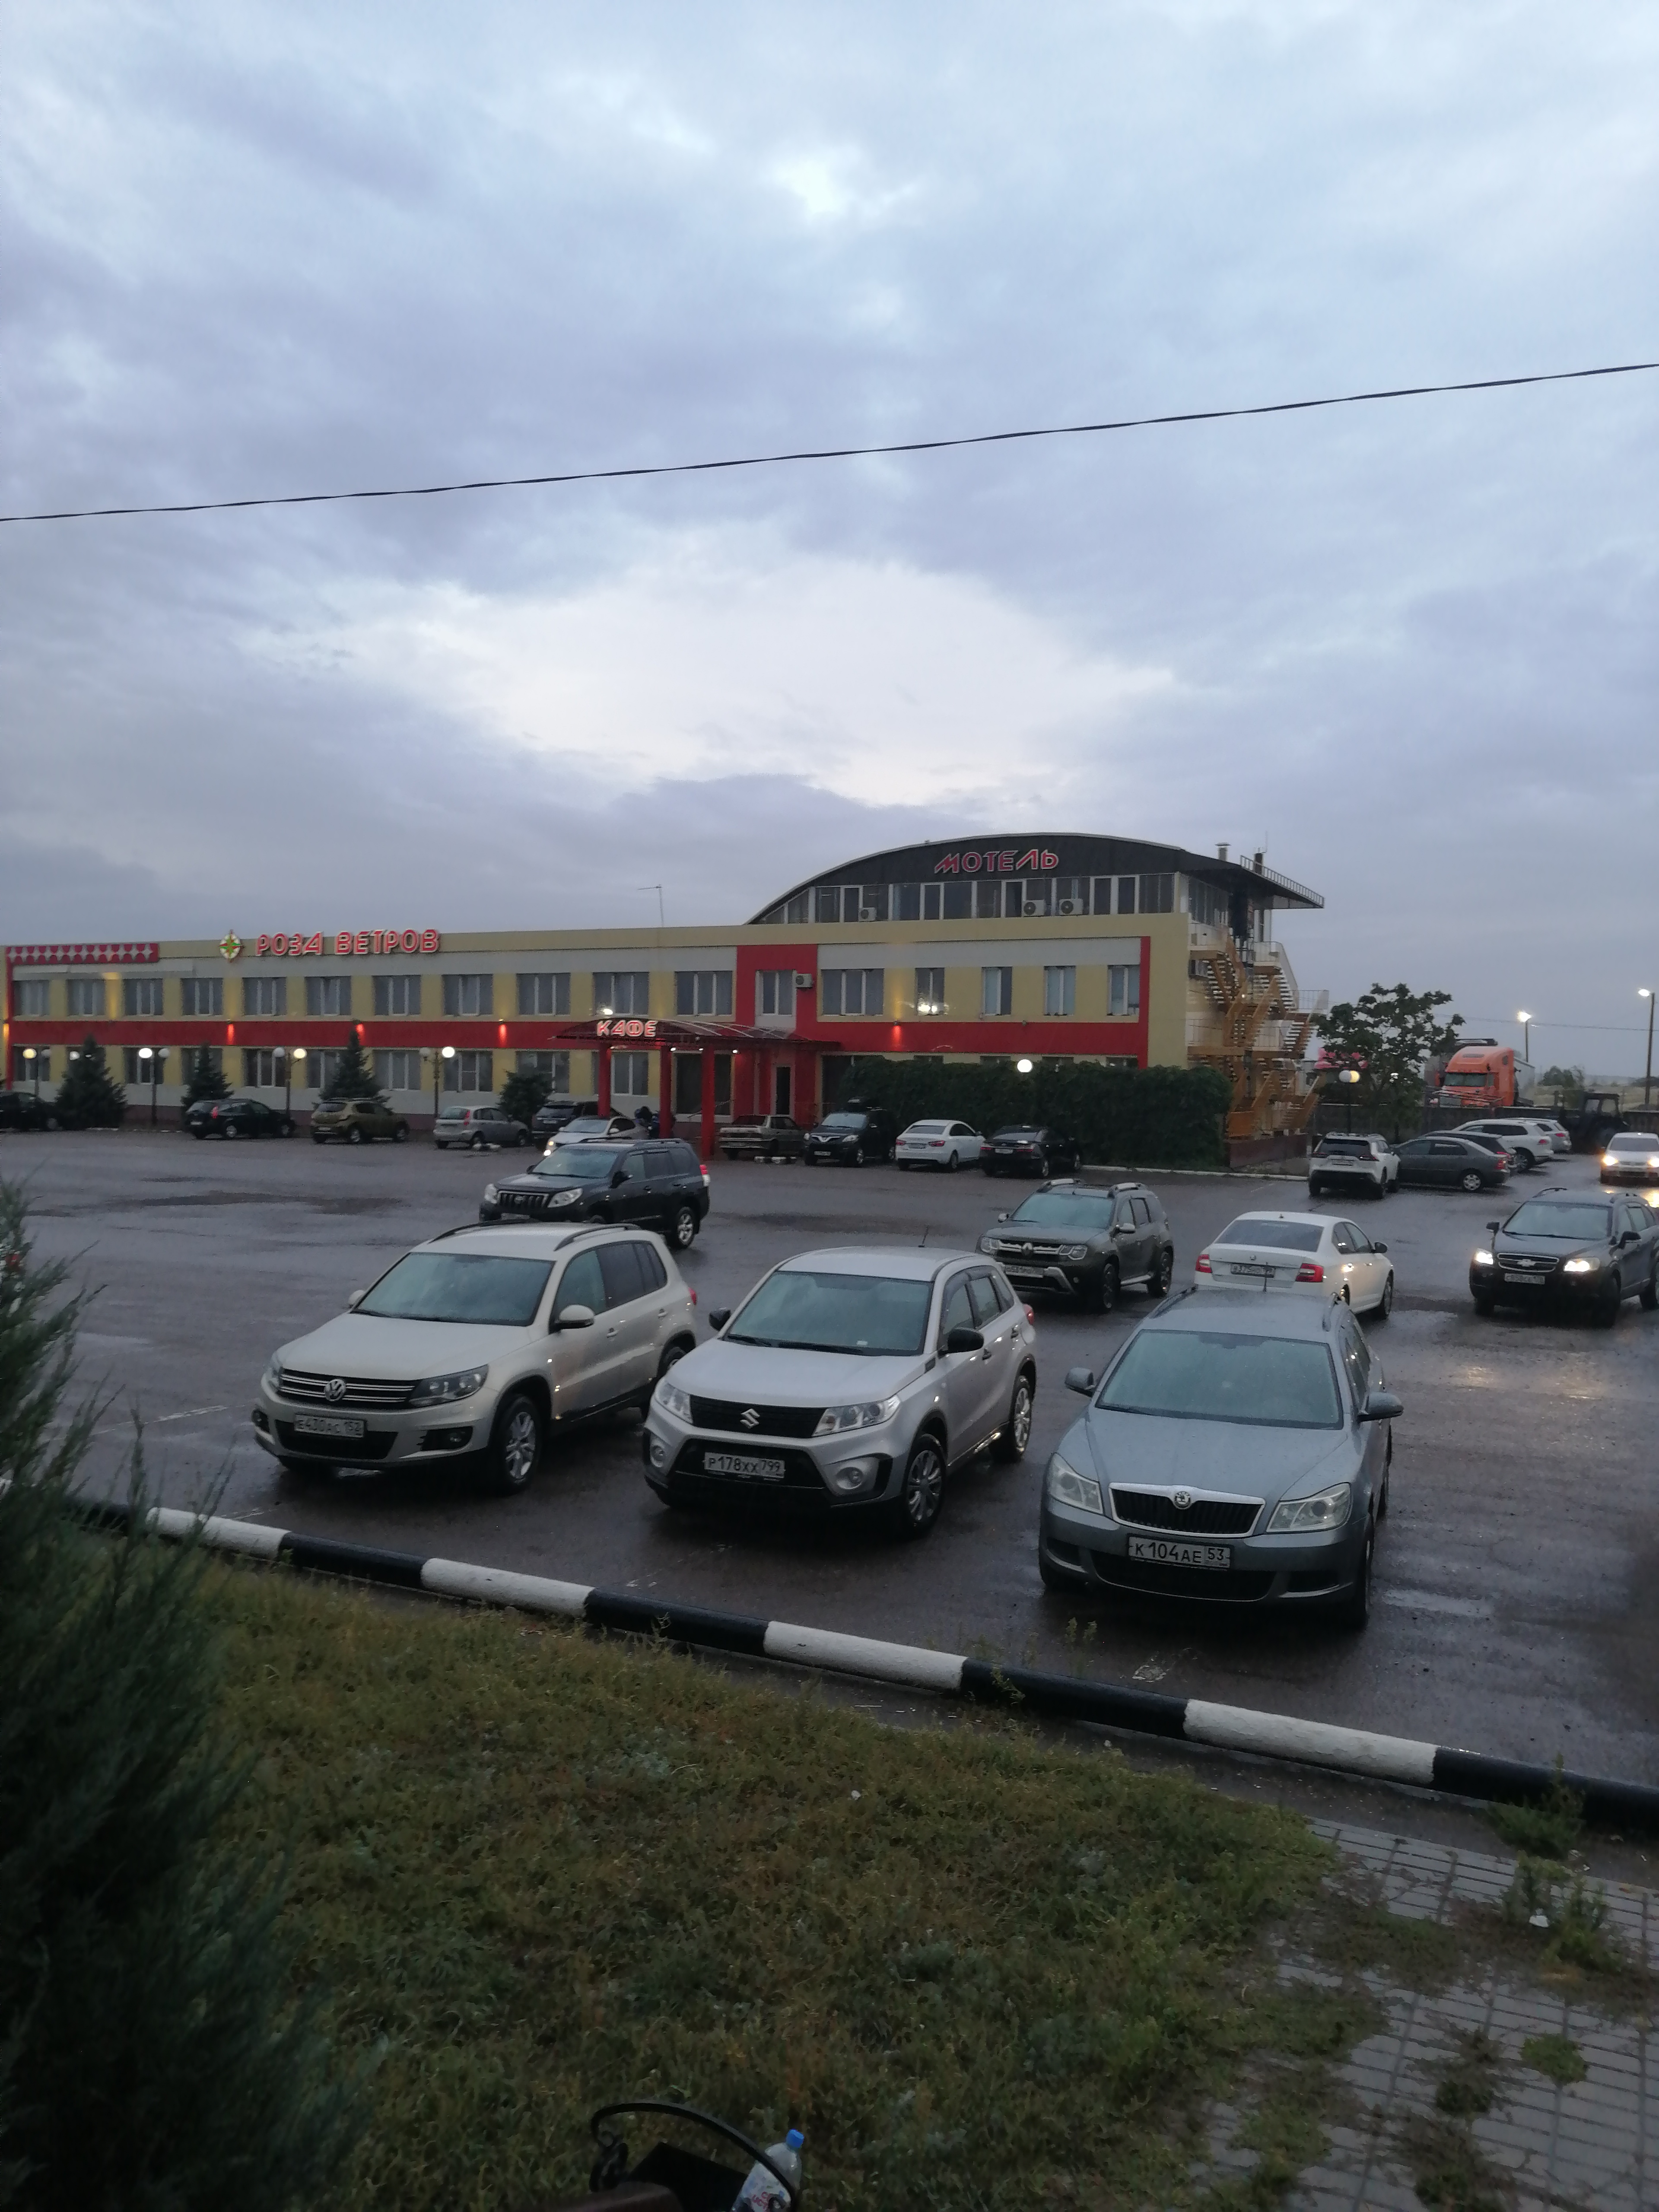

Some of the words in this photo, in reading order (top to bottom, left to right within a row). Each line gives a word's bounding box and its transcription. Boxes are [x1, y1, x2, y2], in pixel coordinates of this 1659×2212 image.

[934, 849, 1059, 874] МОТЕЛЬ
[255, 931, 324, 957] РОЗА
[334, 928, 440, 955] ВЕТРОВ
[597, 1020, 659, 1037] КАФЕ
